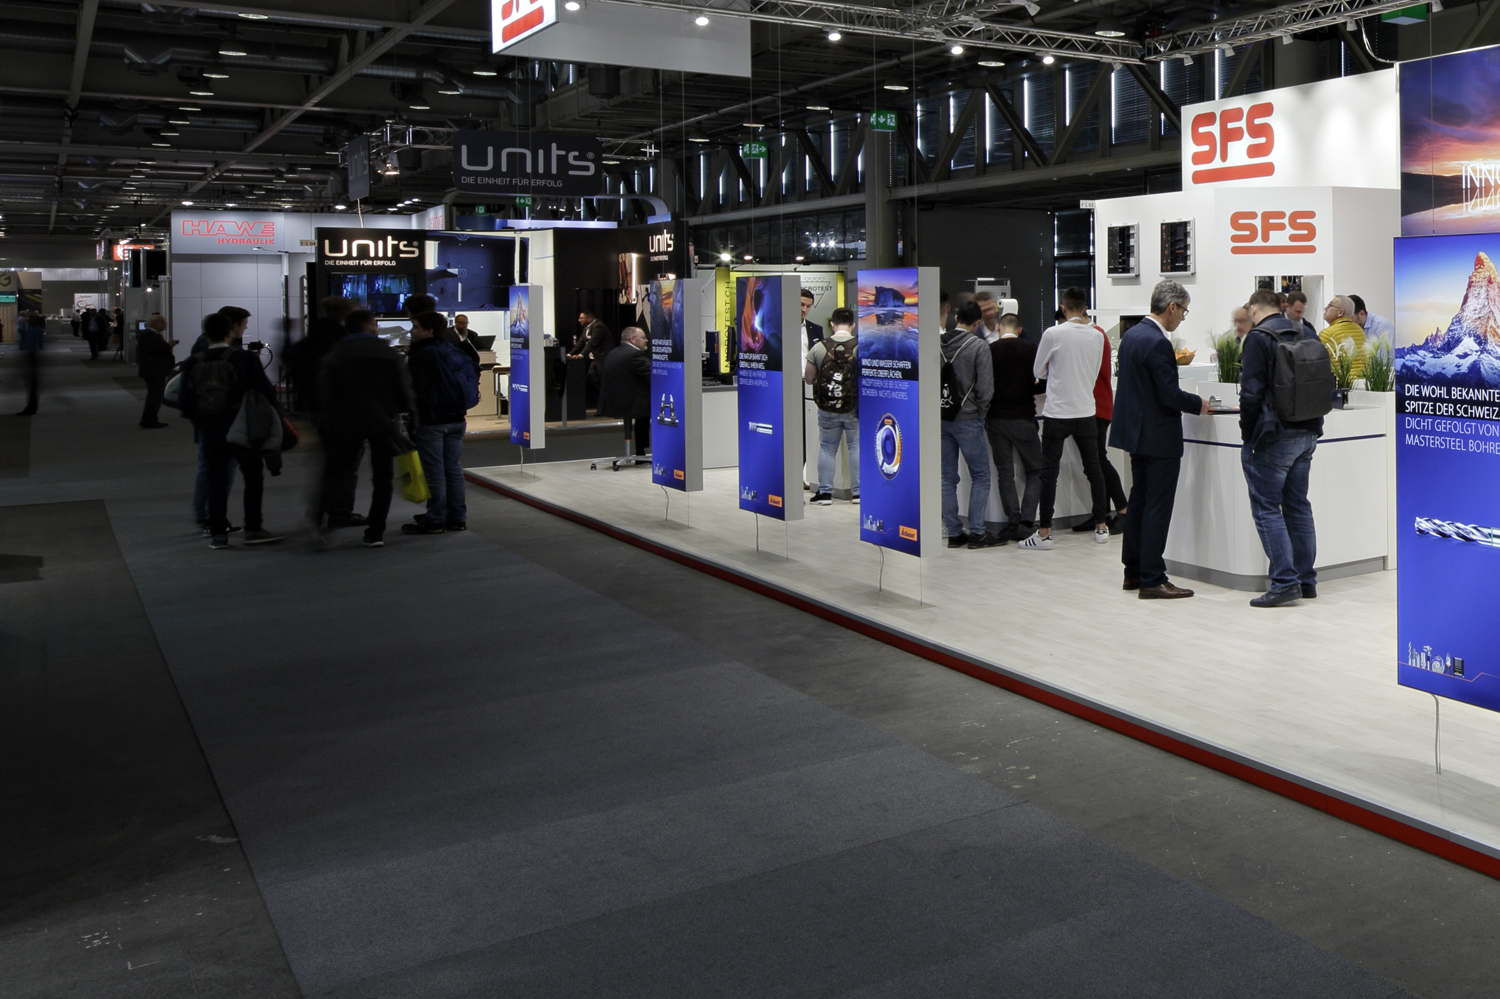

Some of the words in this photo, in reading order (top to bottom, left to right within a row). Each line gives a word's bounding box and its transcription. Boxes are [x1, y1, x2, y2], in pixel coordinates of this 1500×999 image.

[1191, 101, 1274, 165] SFS
[461, 176, 476, 184] DIE
[477, 177, 511, 186] EINHEIT
[512, 176, 529, 186] FÜR
[531, 179, 563, 188] ERFOLG
[182, 219, 275, 237] HAWE
[1230, 210, 1317, 243] SFS
[360, 258, 373, 266] FÜR
[1405, 384, 1420, 397] DIE
[1420, 385, 1449, 399] WOHL
[1405, 400, 1434, 415] SPITZE
[1436, 402, 1455, 416] DER
[1405, 417, 1433, 431] DICHT
[1434, 419, 1477, 435] GEFOLGT
[1477, 423, 1500, 437] VON
[1405, 433, 1467, 451] MASTERSTEEL
